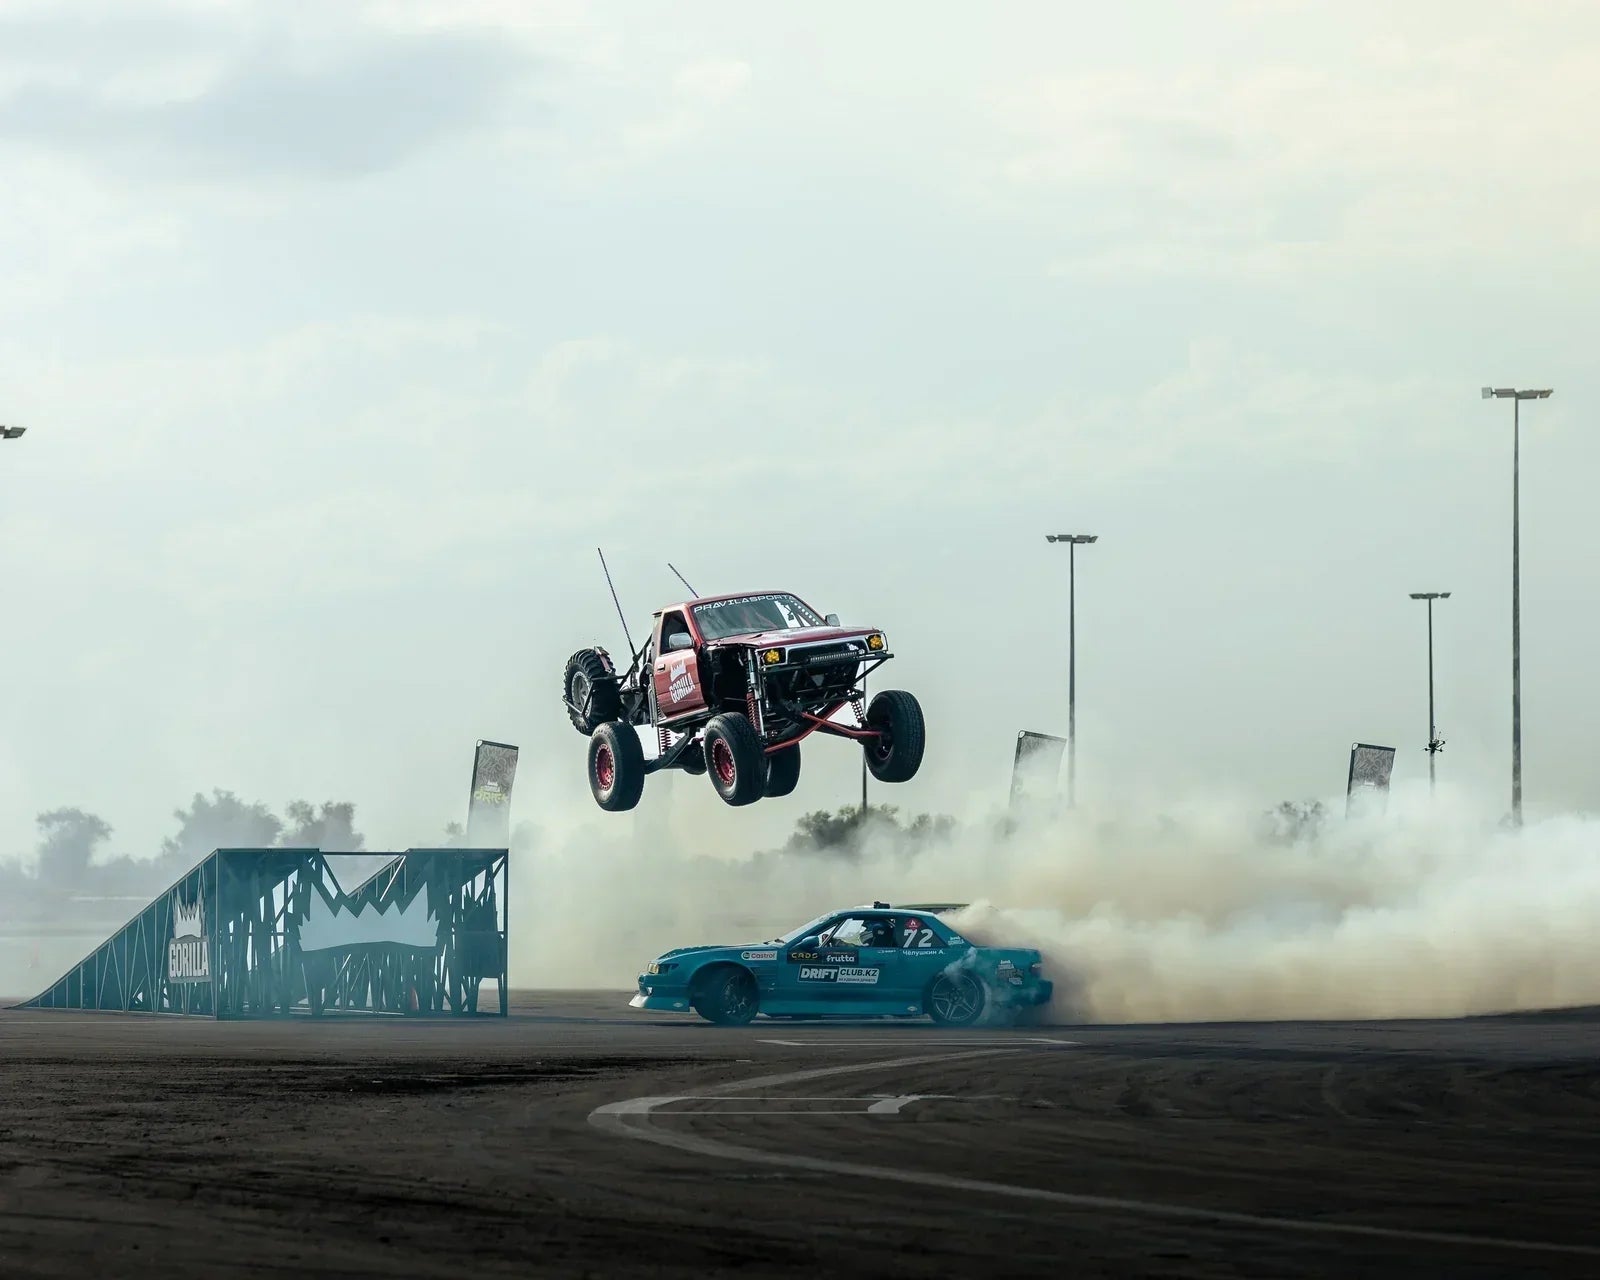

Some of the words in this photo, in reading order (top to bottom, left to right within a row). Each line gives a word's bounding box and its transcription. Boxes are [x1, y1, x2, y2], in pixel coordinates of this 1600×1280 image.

[902, 928, 934, 949] 72
[170, 941, 209, 978] GORILLA
[826, 954, 855, 963] frutta
[800, 968, 838, 979] DRIFT
[840, 969, 878, 977] CLUB.KZ
